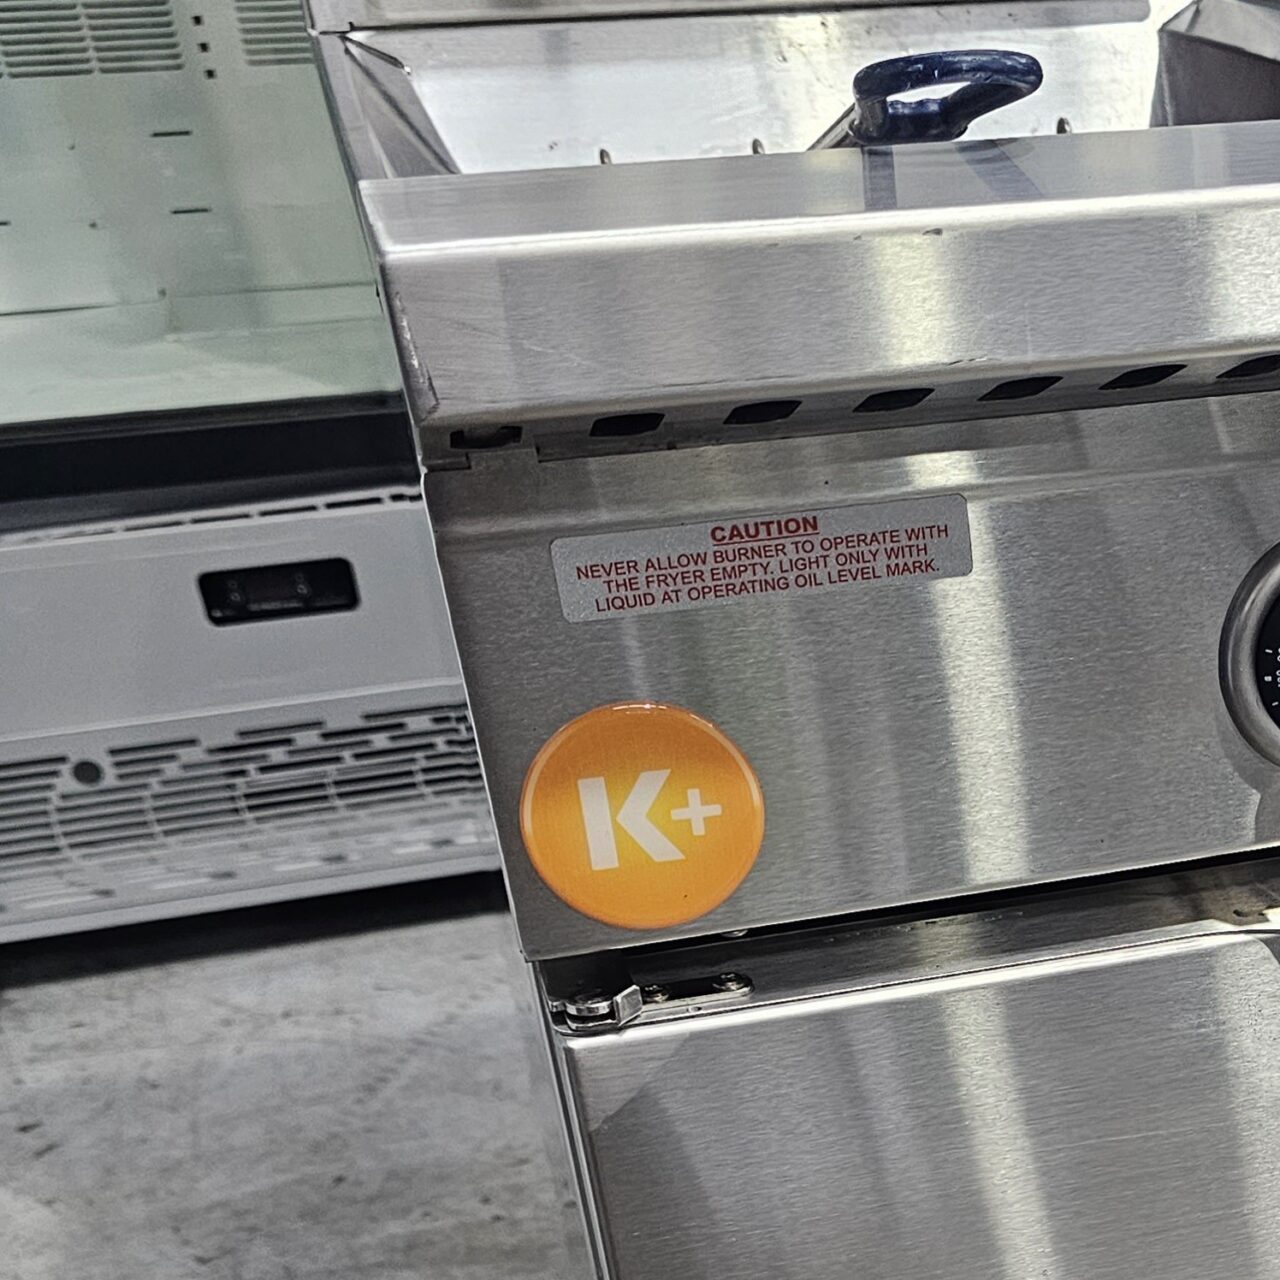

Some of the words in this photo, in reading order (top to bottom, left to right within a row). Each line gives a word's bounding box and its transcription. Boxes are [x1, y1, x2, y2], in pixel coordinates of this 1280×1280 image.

[576, 559, 640, 580] NEVER
[644, 551, 708, 573] ALLOW
[713, 543, 787, 564] BURNER
[791, 539, 815, 554] TO
[820, 529, 901, 551] OPERATE
[904, 524, 949, 542] WITH
[710, 516, 819, 543] CAUTION
[595, 592, 656, 612] LIQUID
[661, 589, 682, 605] AT
[687, 576, 790, 601] OPERATING
[794, 573, 824, 588] OIL
[827, 566, 882, 584] LEVEL
[885, 559, 940, 577] MARK.
[603, 576, 640, 594] THE
[645, 569, 706, 589] FRYER
[710, 561, 775, 582] EMPTY.
[779, 554, 830, 574] LIGHT
[835, 548, 879, 566] ONLY
[884, 543, 928, 560] WITH
[577, 768, 722, 871] K+
